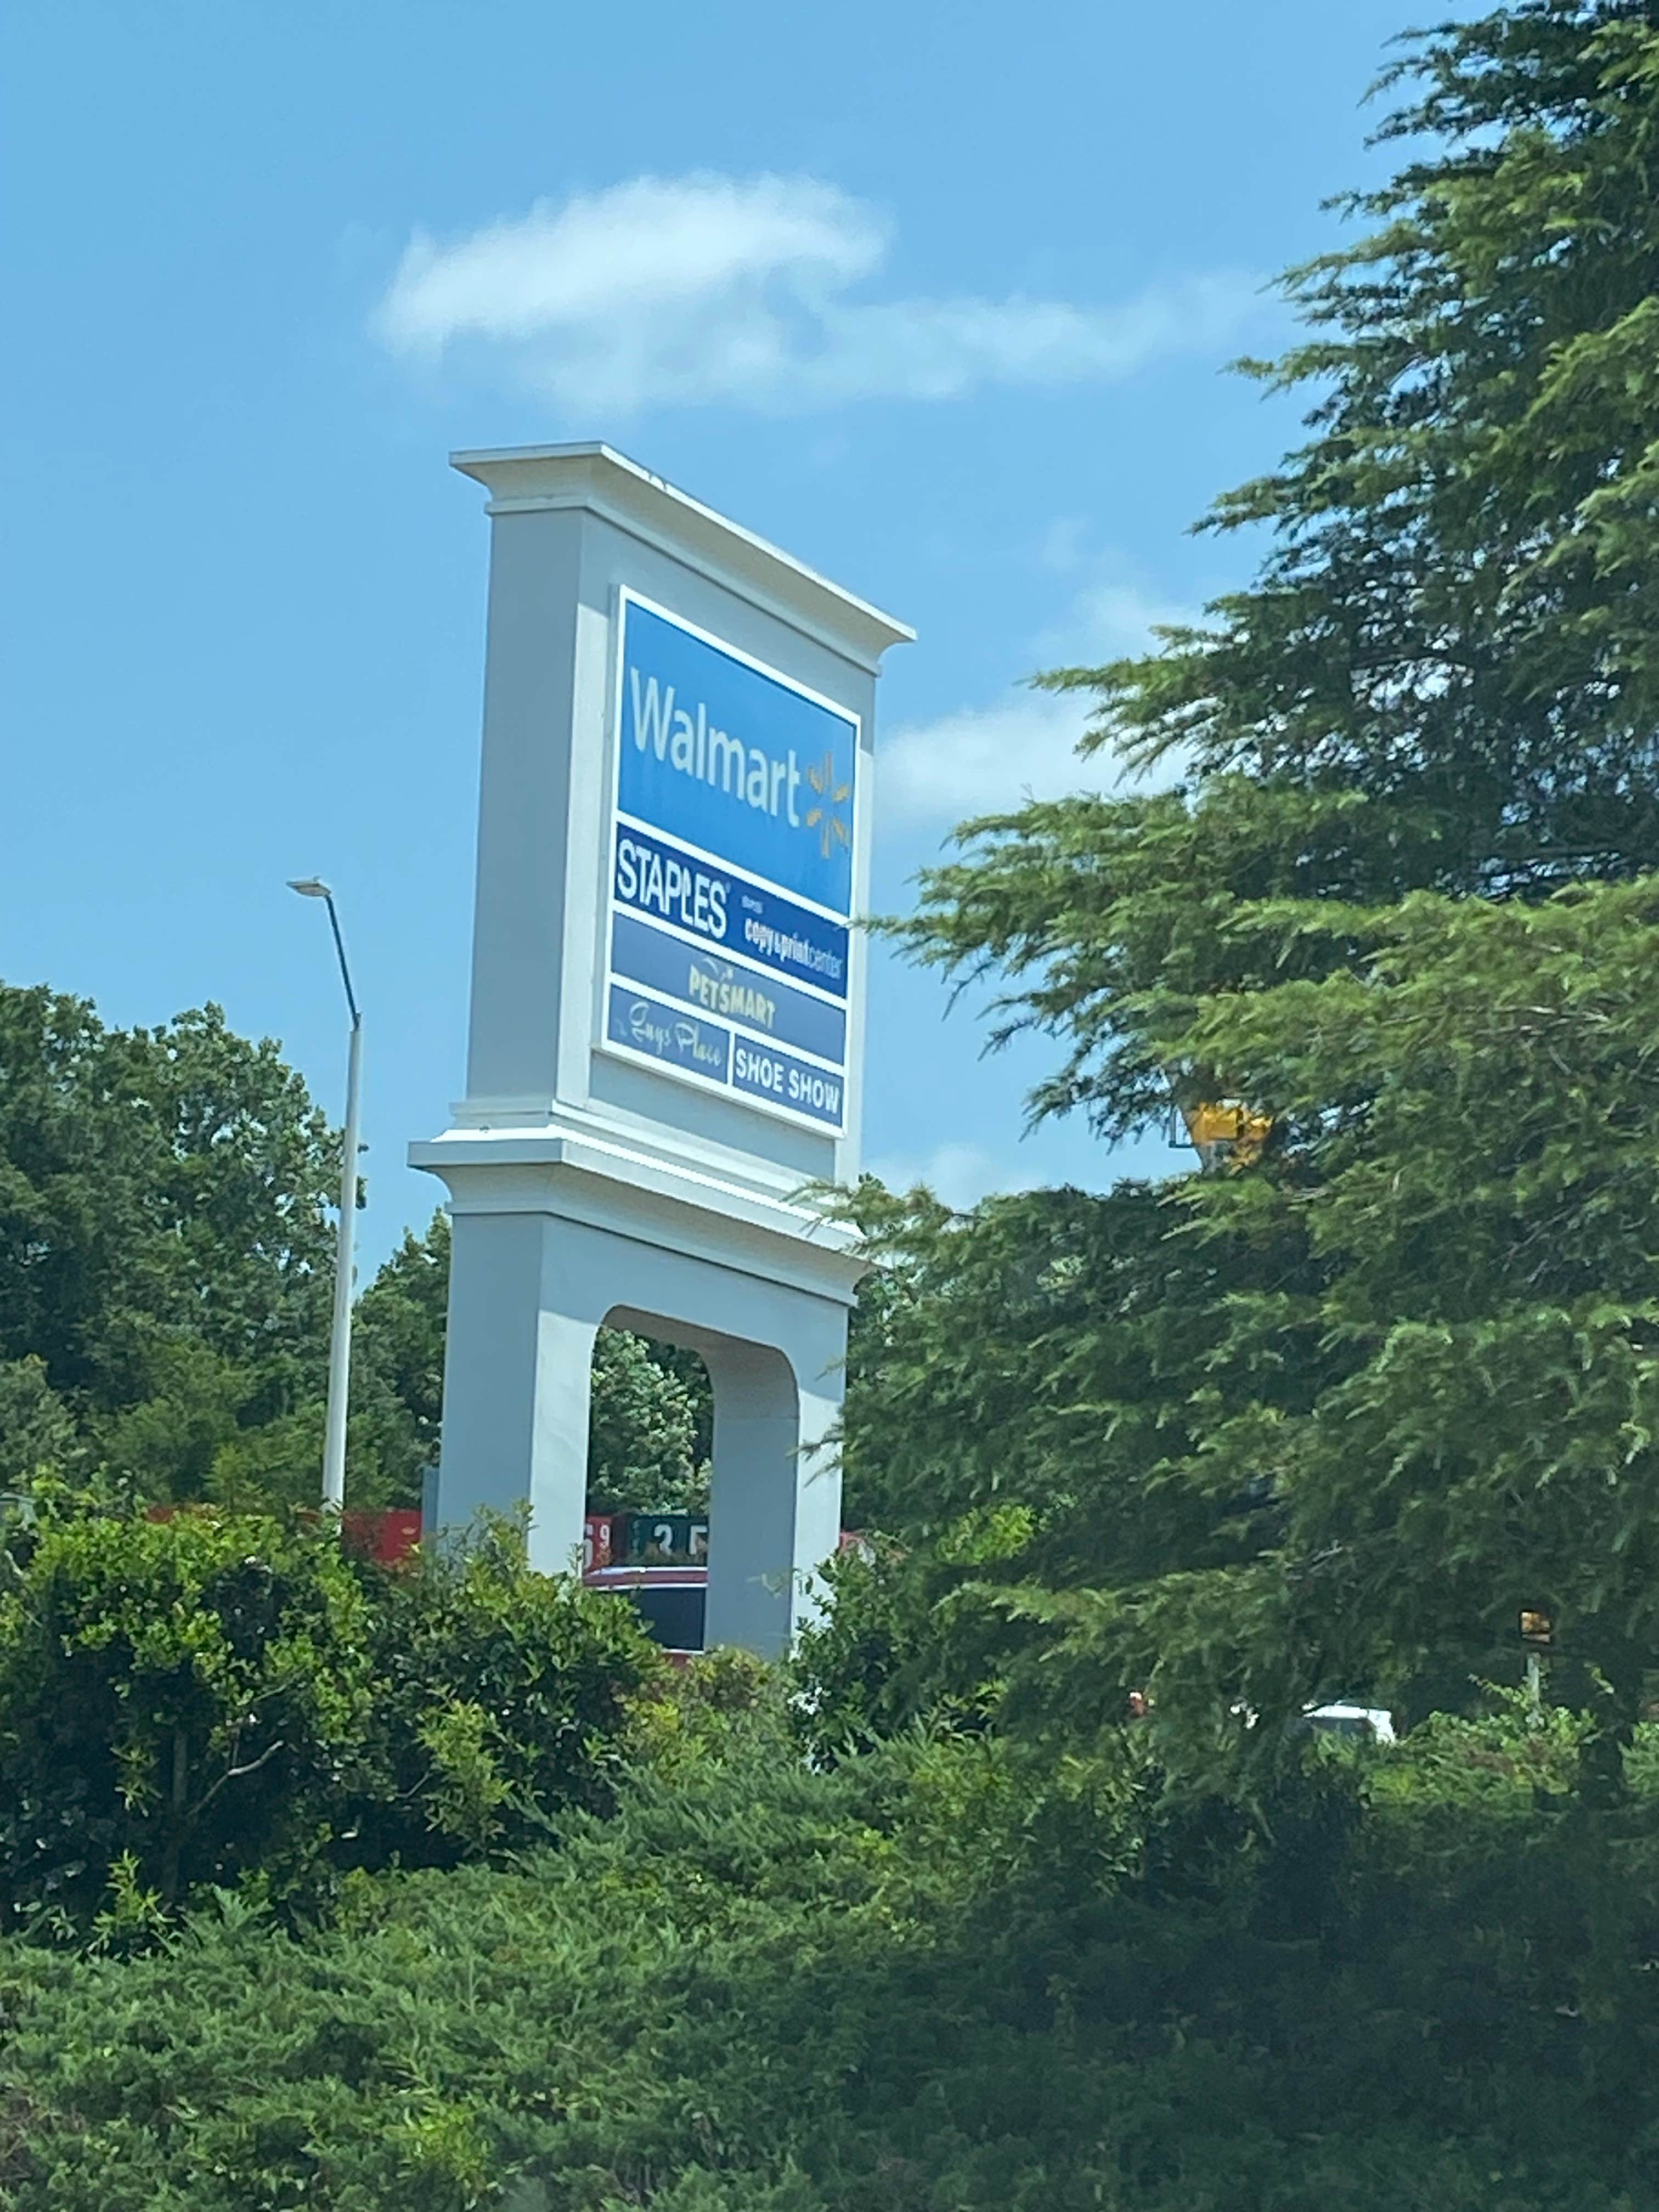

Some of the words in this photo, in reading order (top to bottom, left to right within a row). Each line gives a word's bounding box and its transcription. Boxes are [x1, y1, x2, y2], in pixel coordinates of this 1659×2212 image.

[630, 667, 801, 828] Walmart
[618, 838, 727, 939] STAPLES
[689, 964, 775, 1029] PETSMART
[736, 1047, 784, 1093] SHOE
[788, 1069, 839, 1114] SHOW
